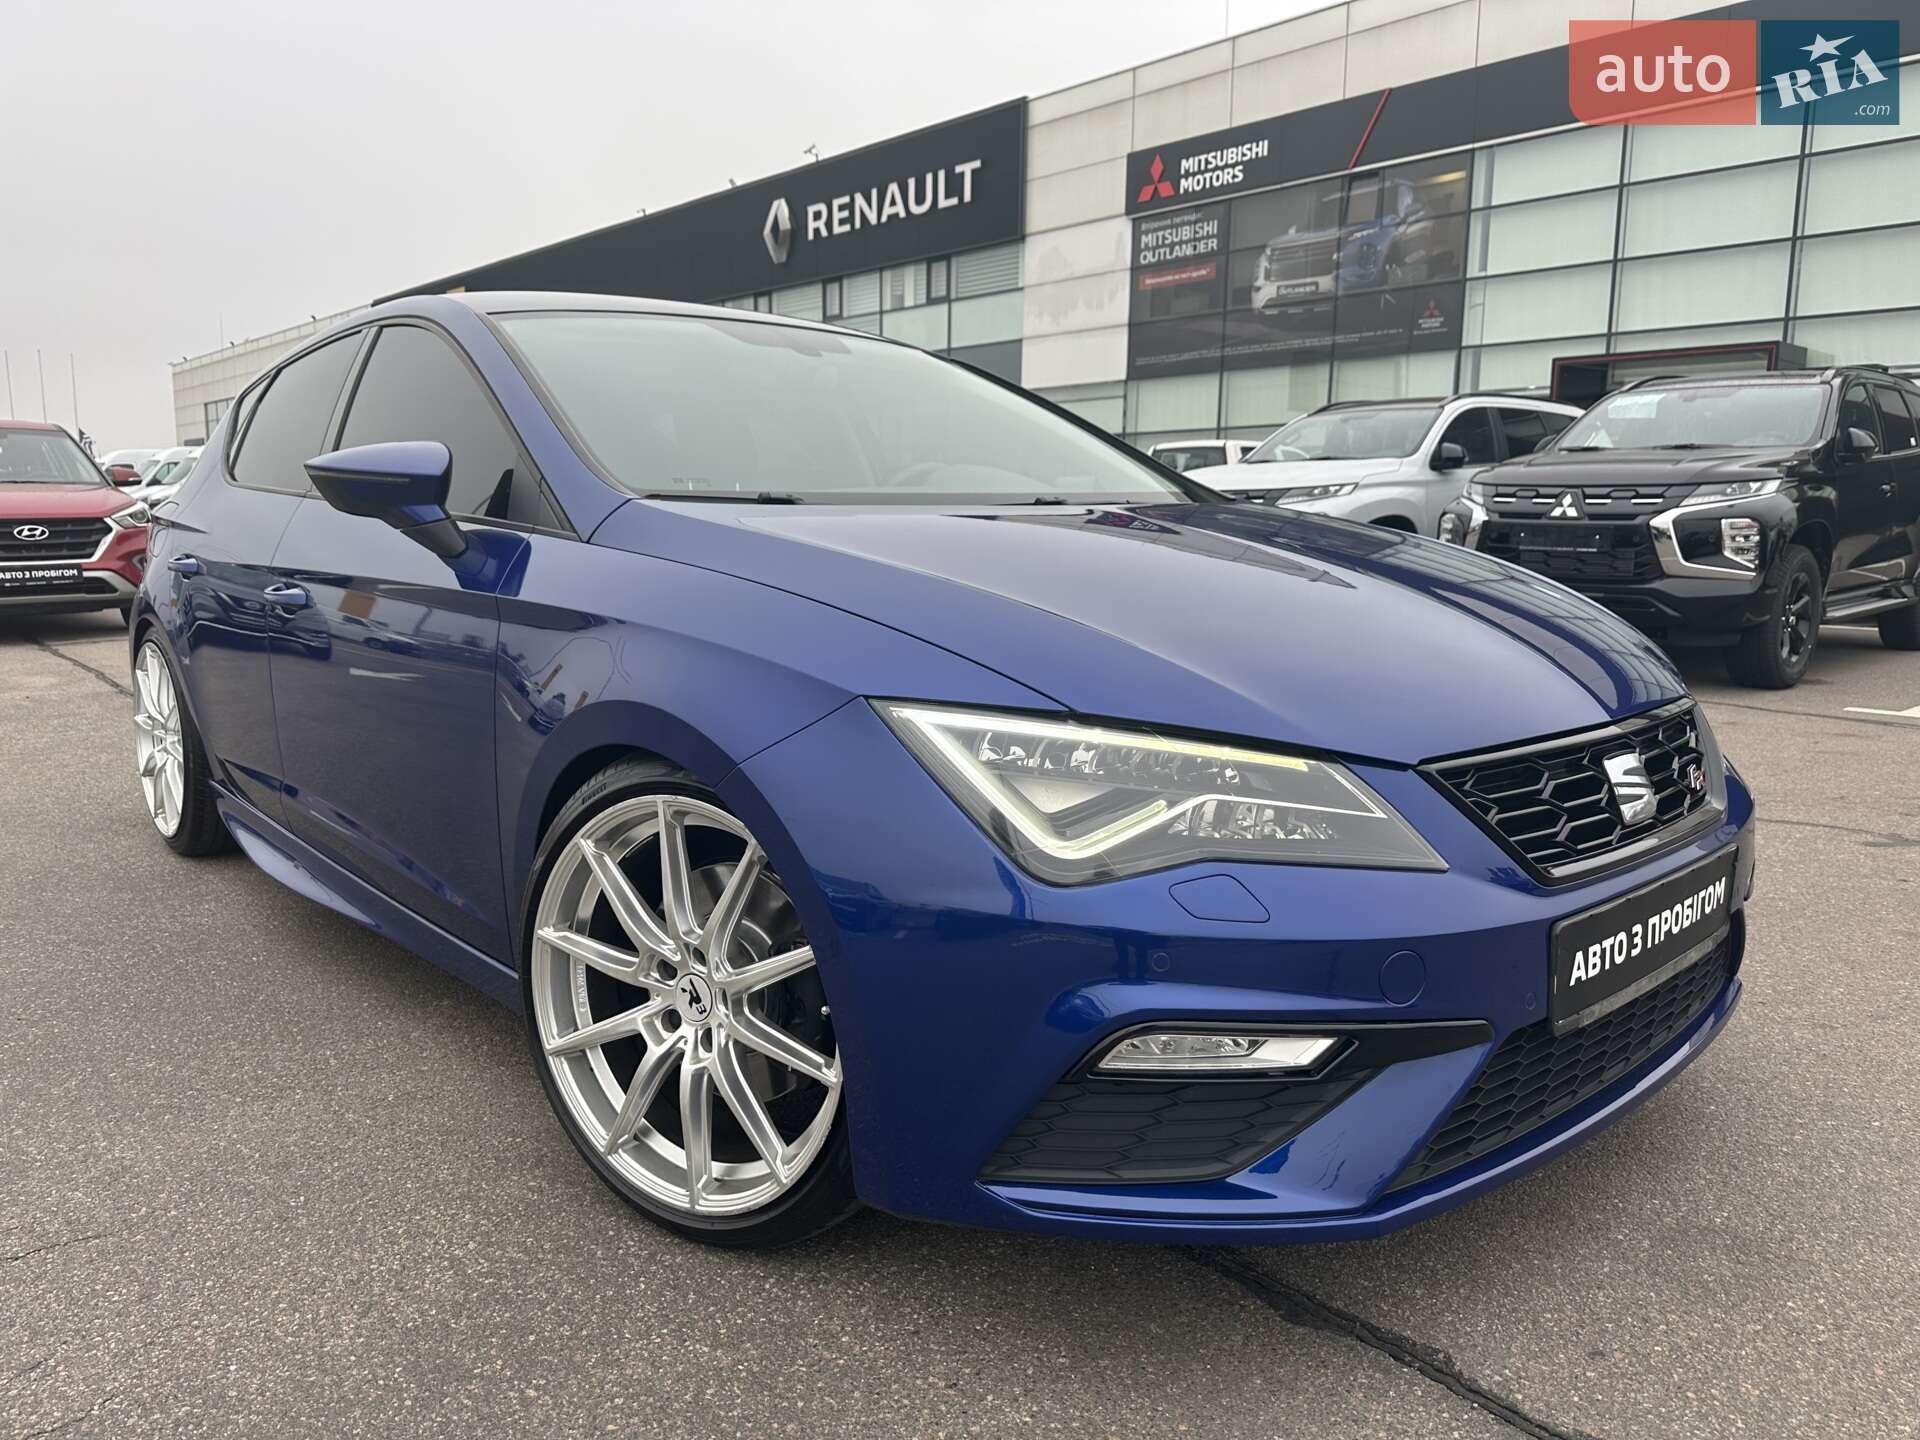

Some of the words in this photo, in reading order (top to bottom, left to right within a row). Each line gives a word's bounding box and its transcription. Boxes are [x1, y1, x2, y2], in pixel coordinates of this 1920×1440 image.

[1180, 139, 1269, 175] MITSUBISHI
[1179, 165, 1244, 195] MOTORS
[806, 159, 982, 241] RENAULT
[1141, 219, 1218, 249] MITSUBISHI
[1140, 238, 1218, 265] OUTLANDER
[0, 571, 23, 579] АВТО
[31, 569, 78, 578] ПРОБІГОМ
[1569, 931, 1628, 986] АВТО
[1647, 876, 1726, 948] ПРОБІГОМ
